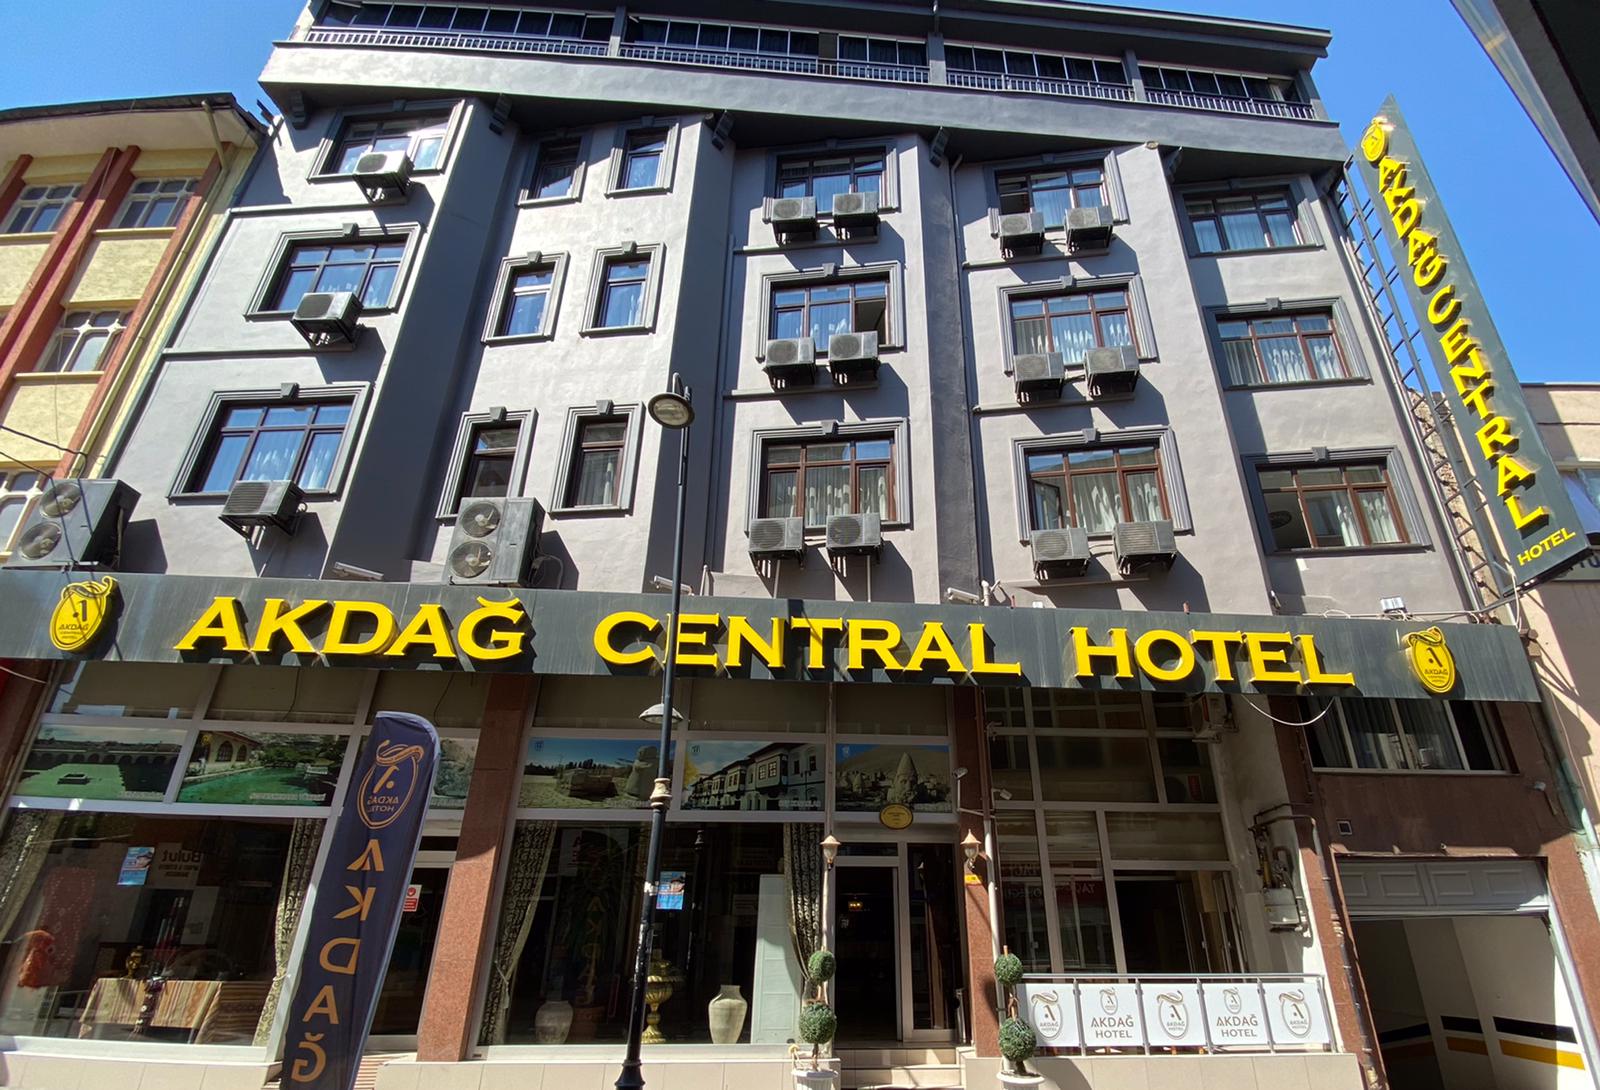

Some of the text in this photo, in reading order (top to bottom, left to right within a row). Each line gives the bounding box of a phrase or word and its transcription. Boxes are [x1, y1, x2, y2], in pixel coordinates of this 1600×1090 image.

[1427, 284, 1544, 530] CENTRAL
[1516, 527, 1577, 567] HOTEL
[173, 595, 1356, 686] AKDAĞ CENTRAL HOTEL
[1091, 1014, 1134, 1028] AKDAĞ
[1216, 1014, 1259, 1027] AKDAĞ
[1095, 1030, 1132, 1039] HOTEL
[1221, 1028, 1258, 1038] HOTEL
